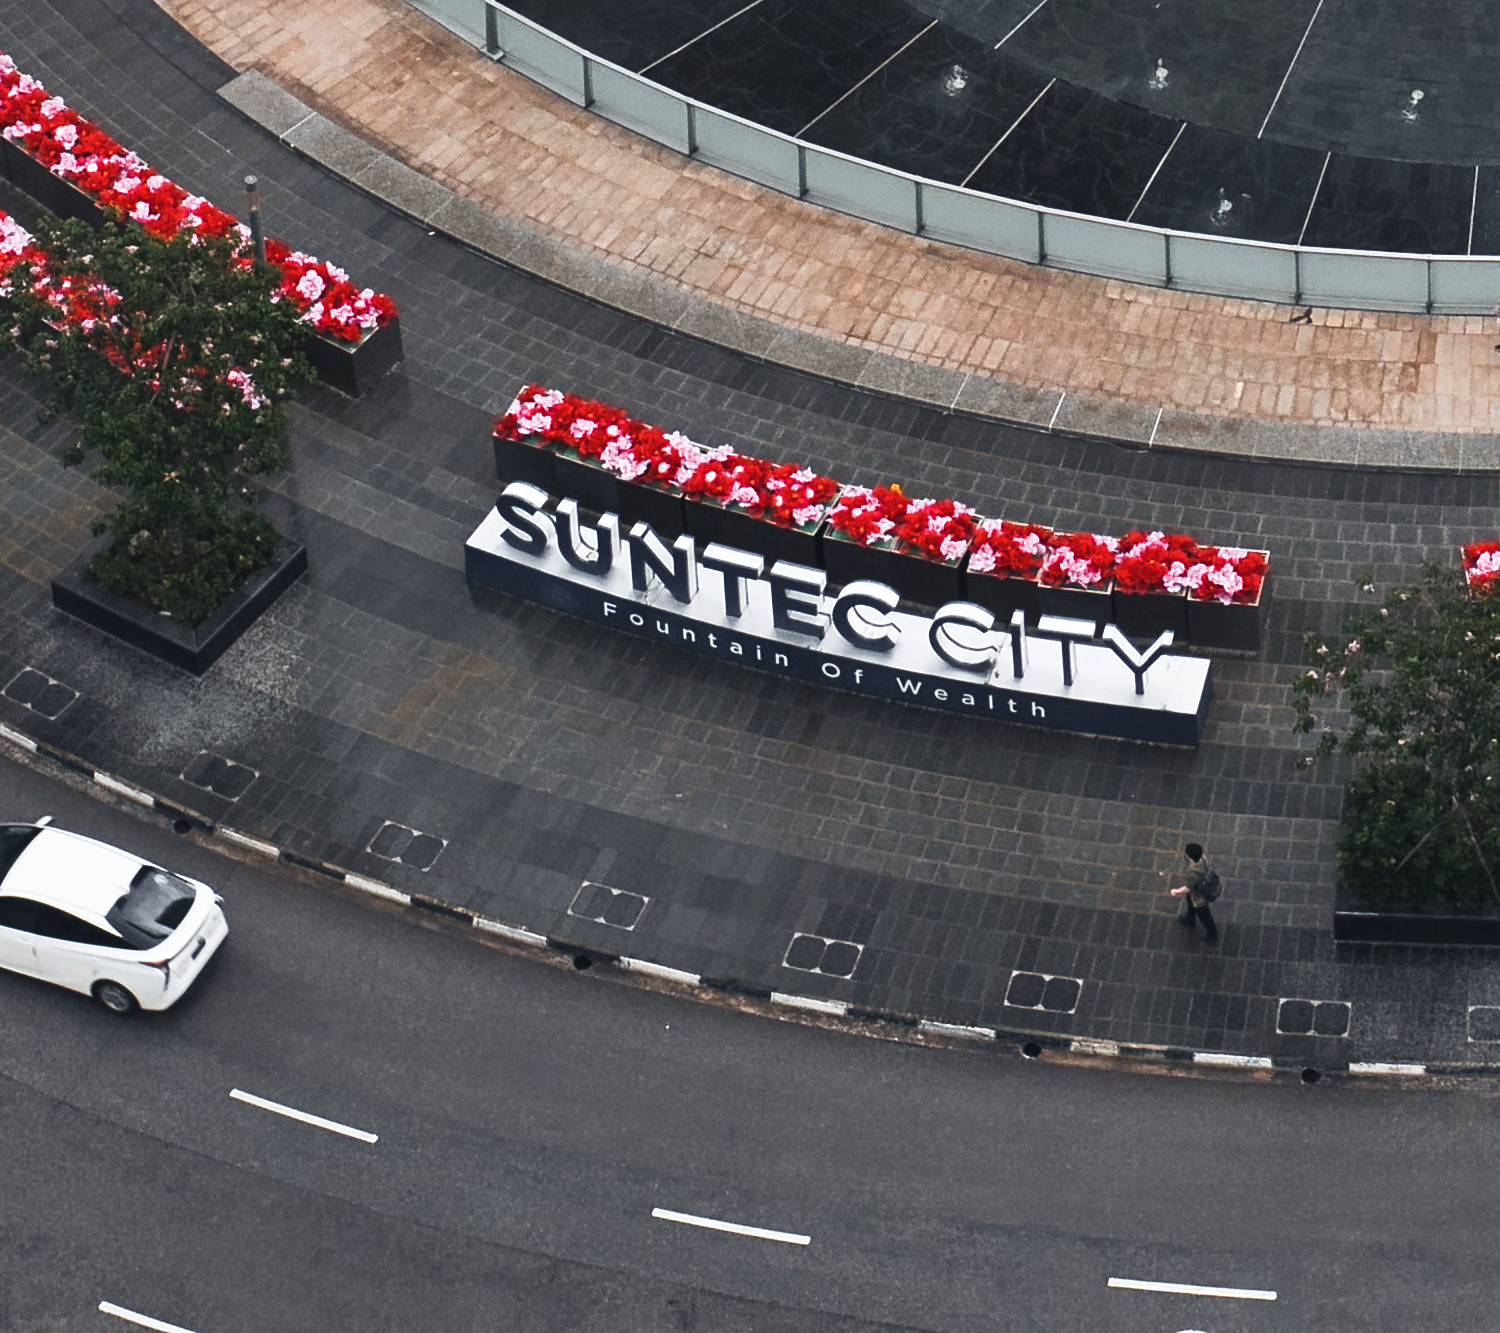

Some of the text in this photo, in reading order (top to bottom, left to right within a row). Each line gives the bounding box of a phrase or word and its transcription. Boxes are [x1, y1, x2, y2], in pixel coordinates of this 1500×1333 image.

[493, 479, 1176, 696] SUNTEC CITY
[601, 600, 1050, 721] Fountain Of Wealth
